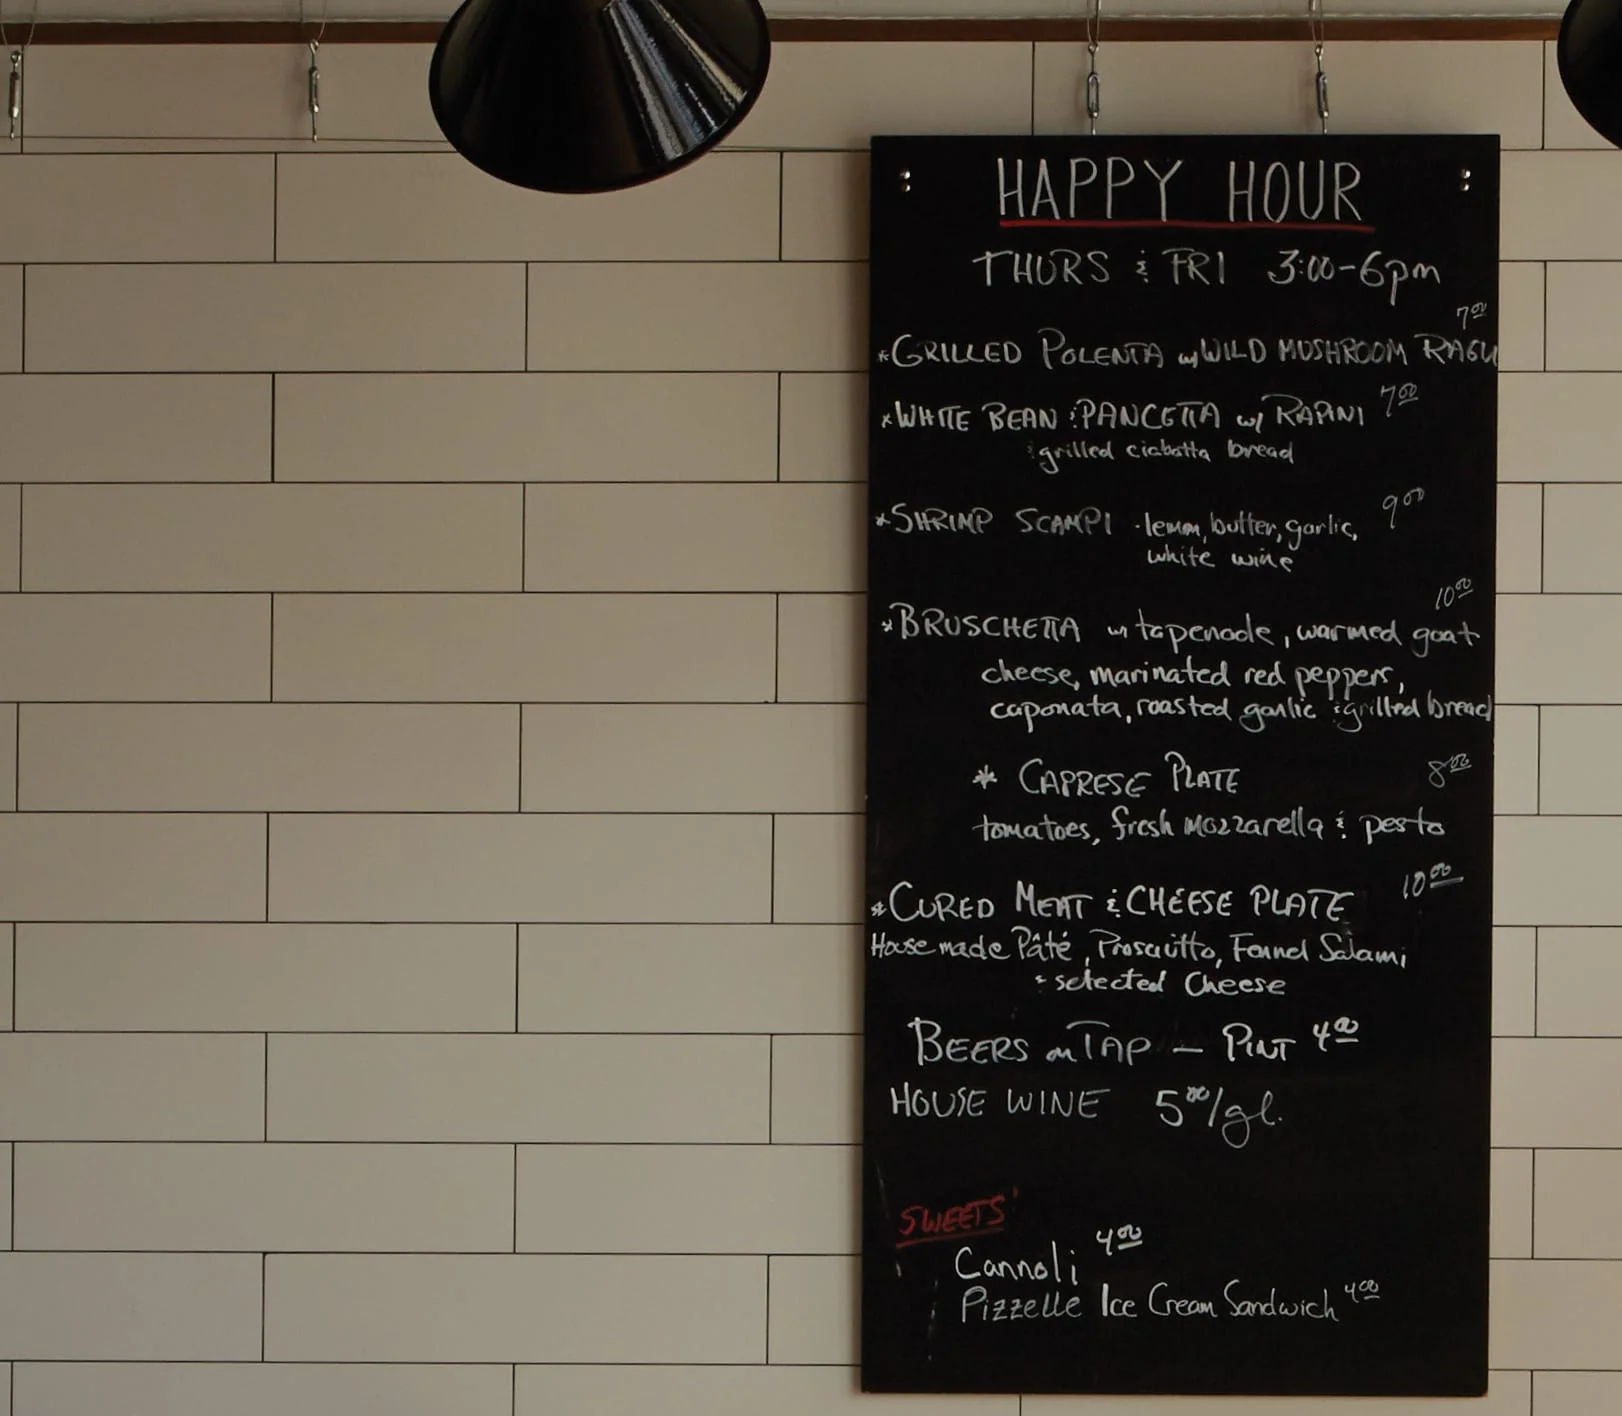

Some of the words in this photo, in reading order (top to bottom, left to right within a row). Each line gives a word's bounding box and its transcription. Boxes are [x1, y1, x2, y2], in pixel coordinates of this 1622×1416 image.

[997, 157, 1183, 222] HAPPY
[1229, 160, 1362, 223] HOUR
[972, 249, 1110, 287] THURS
[1162, 248, 1225, 285] FRI
[892, 334, 1022, 368] GRILLED
[1037, 327, 1164, 370] POLENTA
[1279, 338, 1408, 366] MUSHROOM
[1413, 334, 1498, 366] RAGU
[894, 400, 972, 432] WHITE
[981, 402, 1058, 432] BEAN
[1260, 393, 1365, 427] RAPINI
[1038, 440, 1115, 475] grilled
[1125, 438, 1211, 462] ciabatta
[1227, 438, 1295, 465] bread
[891, 502, 993, 535] SHRIMP
[1015, 506, 1112, 536] SCAMPI
[1146, 543, 1216, 568] white
[1230, 547, 1294, 573] wine
[1296, 619, 1404, 647] warmed
[1410, 621, 1481, 659] goat
[1089, 655, 1232, 688] marinated
[1244, 660, 1287, 687] red
[1136, 694, 1233, 722] roasted
[1238, 696, 1318, 734] garlic
[1427, 688, 1493, 723] bread
[1018, 757, 1154, 799] CAPRESE
[1164, 750, 1242, 795] PLATE
[1110, 804, 1184, 842] fresh
[1359, 806, 1446, 847] pesto
[888, 880, 996, 924] CURED
[1014, 880, 1095, 921] MEAT
[1126, 884, 1236, 921] CHEESE
[1250, 883, 1356, 922] PLATE
[1055, 966, 1167, 993] selected
[1183, 970, 1288, 998] Cheese
[907, 1017, 1031, 1068] BEERS
[1045, 1045, 1079, 1065] on
[1065, 1019, 1153, 1068] TAP
[1221, 1021, 1298, 1063] PINT
[889, 1080, 988, 1119] HOUSE
[1005, 1087, 1112, 1121] WINE
[953, 1239, 1080, 1286] Cannoli
[961, 1284, 1084, 1325] Pizzelle
[1101, 1281, 1139, 1320] Ice
[1147, 1280, 1220, 1320] Cream
[1223, 1277, 1341, 1323] Sandwich
